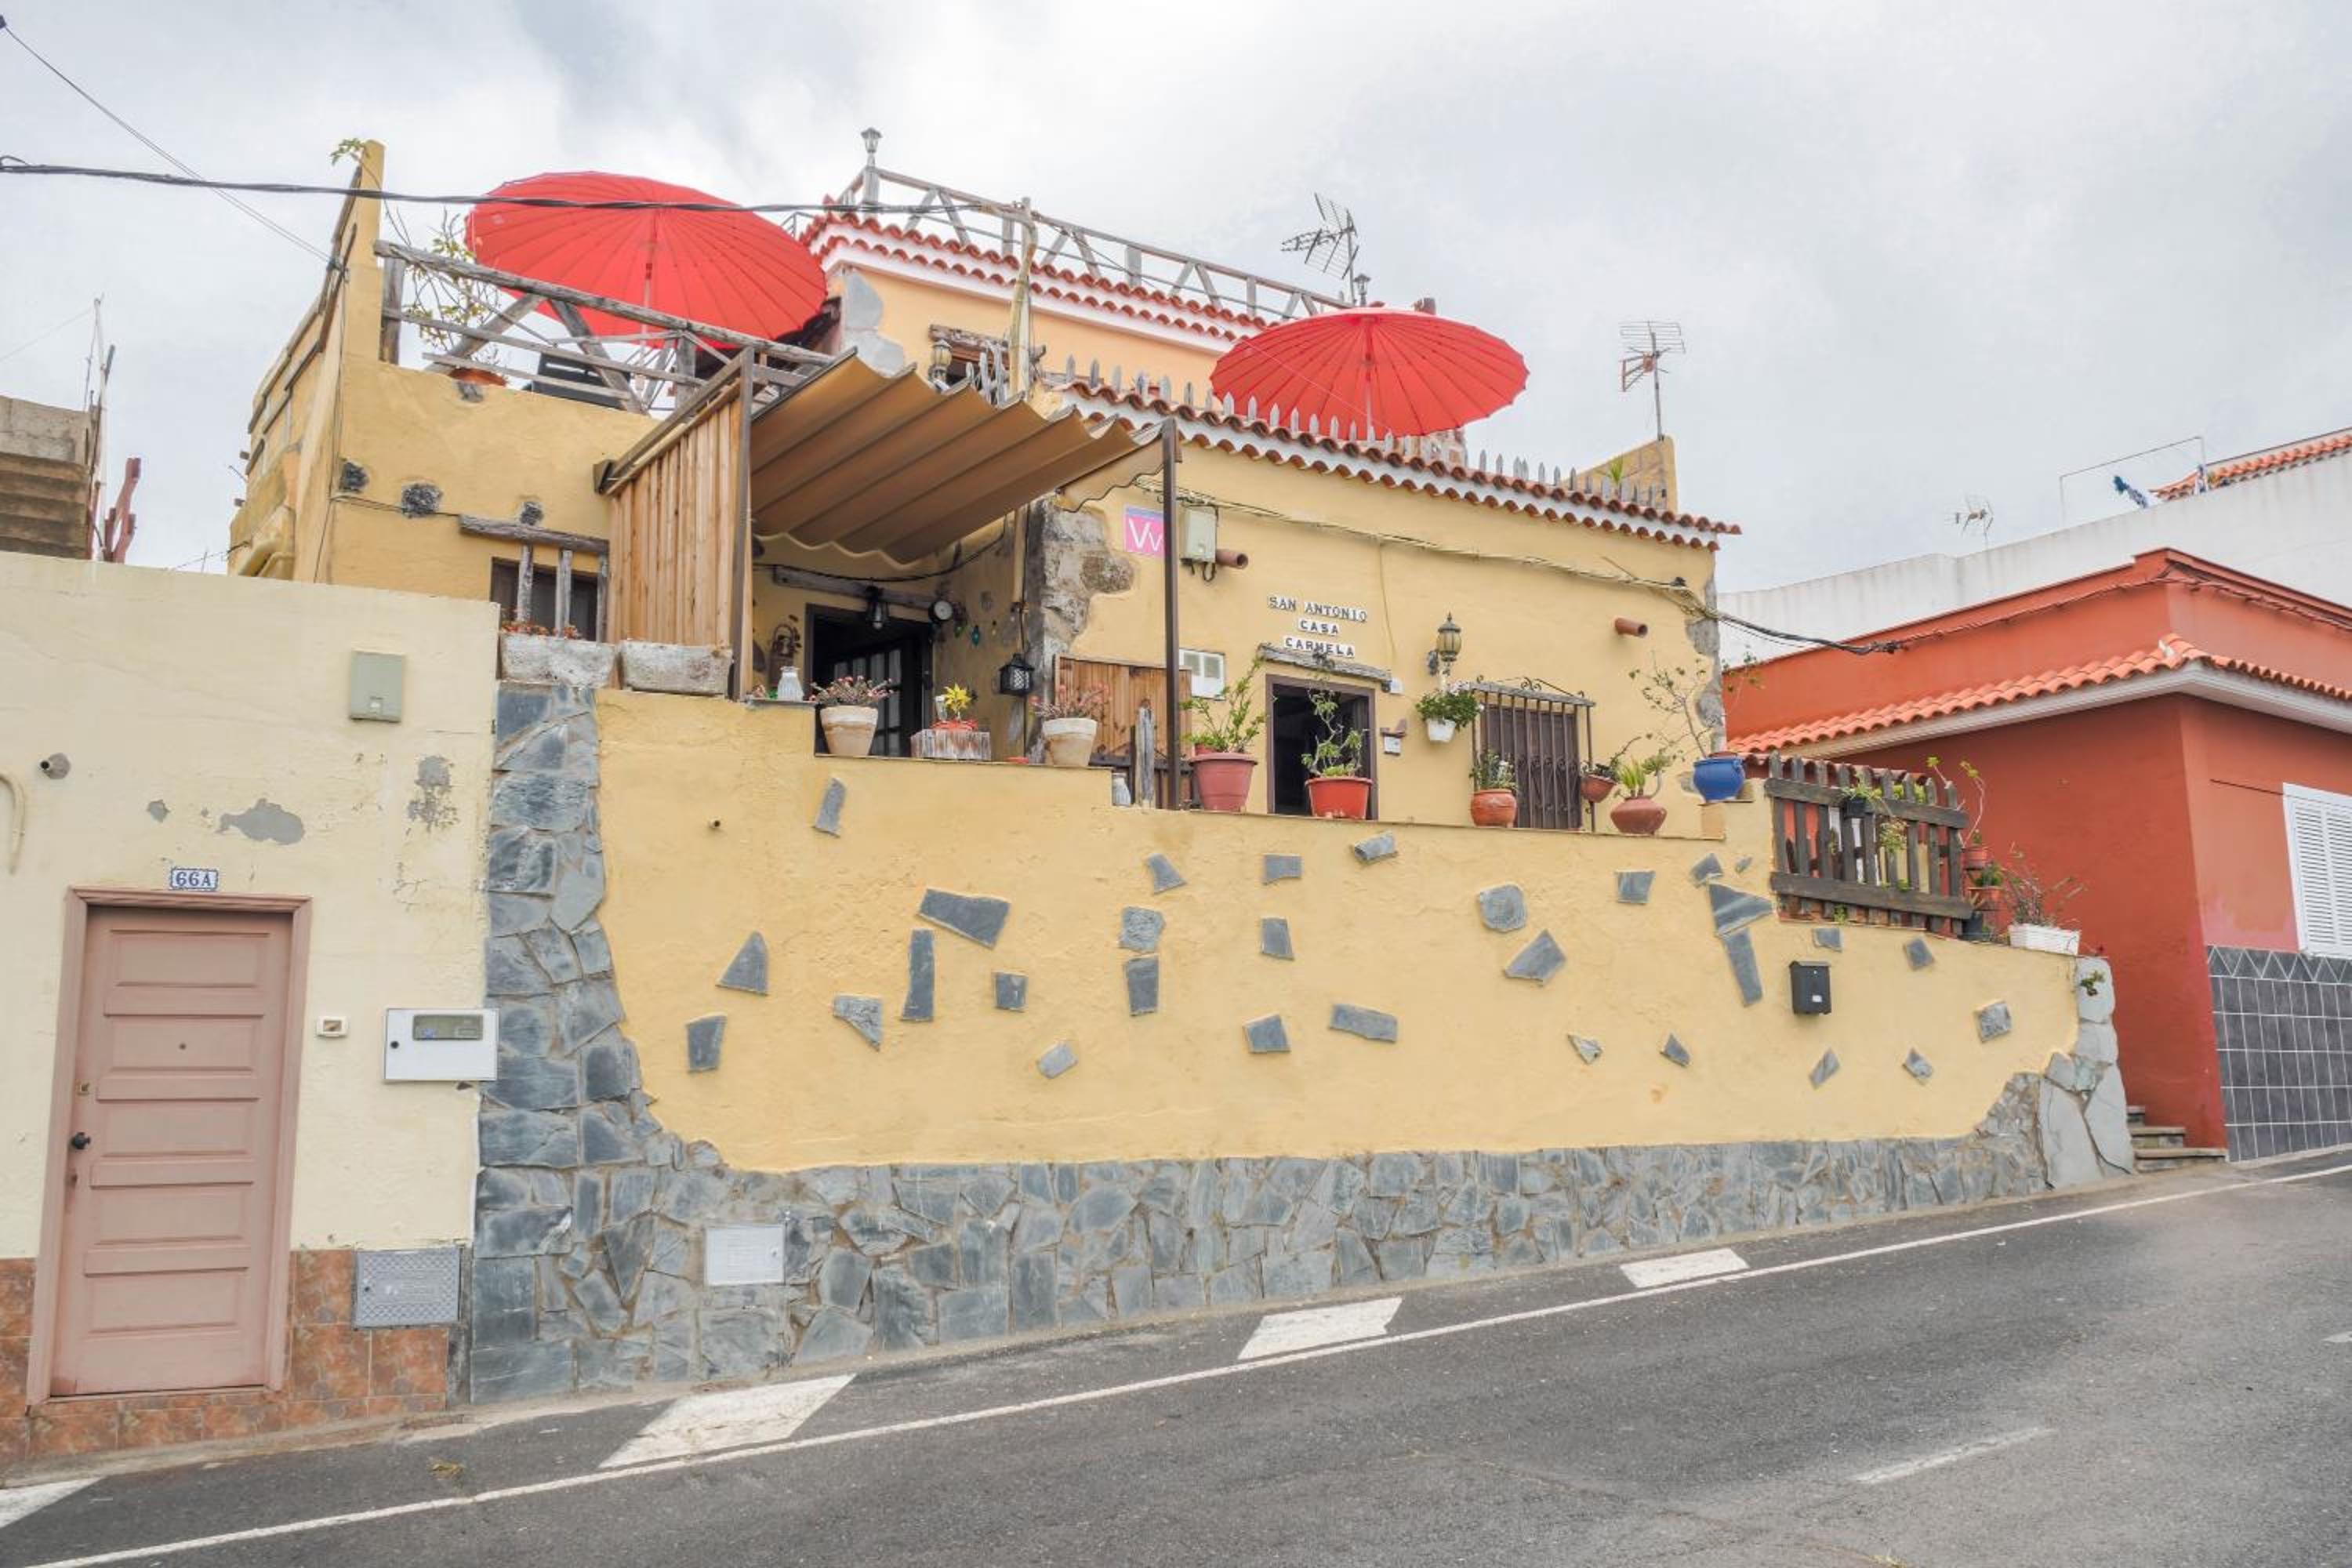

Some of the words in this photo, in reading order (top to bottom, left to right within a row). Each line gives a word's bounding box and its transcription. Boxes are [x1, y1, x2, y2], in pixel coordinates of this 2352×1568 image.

[1269, 596, 1297, 612] SAN
[1304, 602, 1368, 623] ANTONIO
[1299, 619, 1339, 635] CASA
[1285, 637, 1355, 657] CARMELA
[175, 871, 212, 887] 66A
